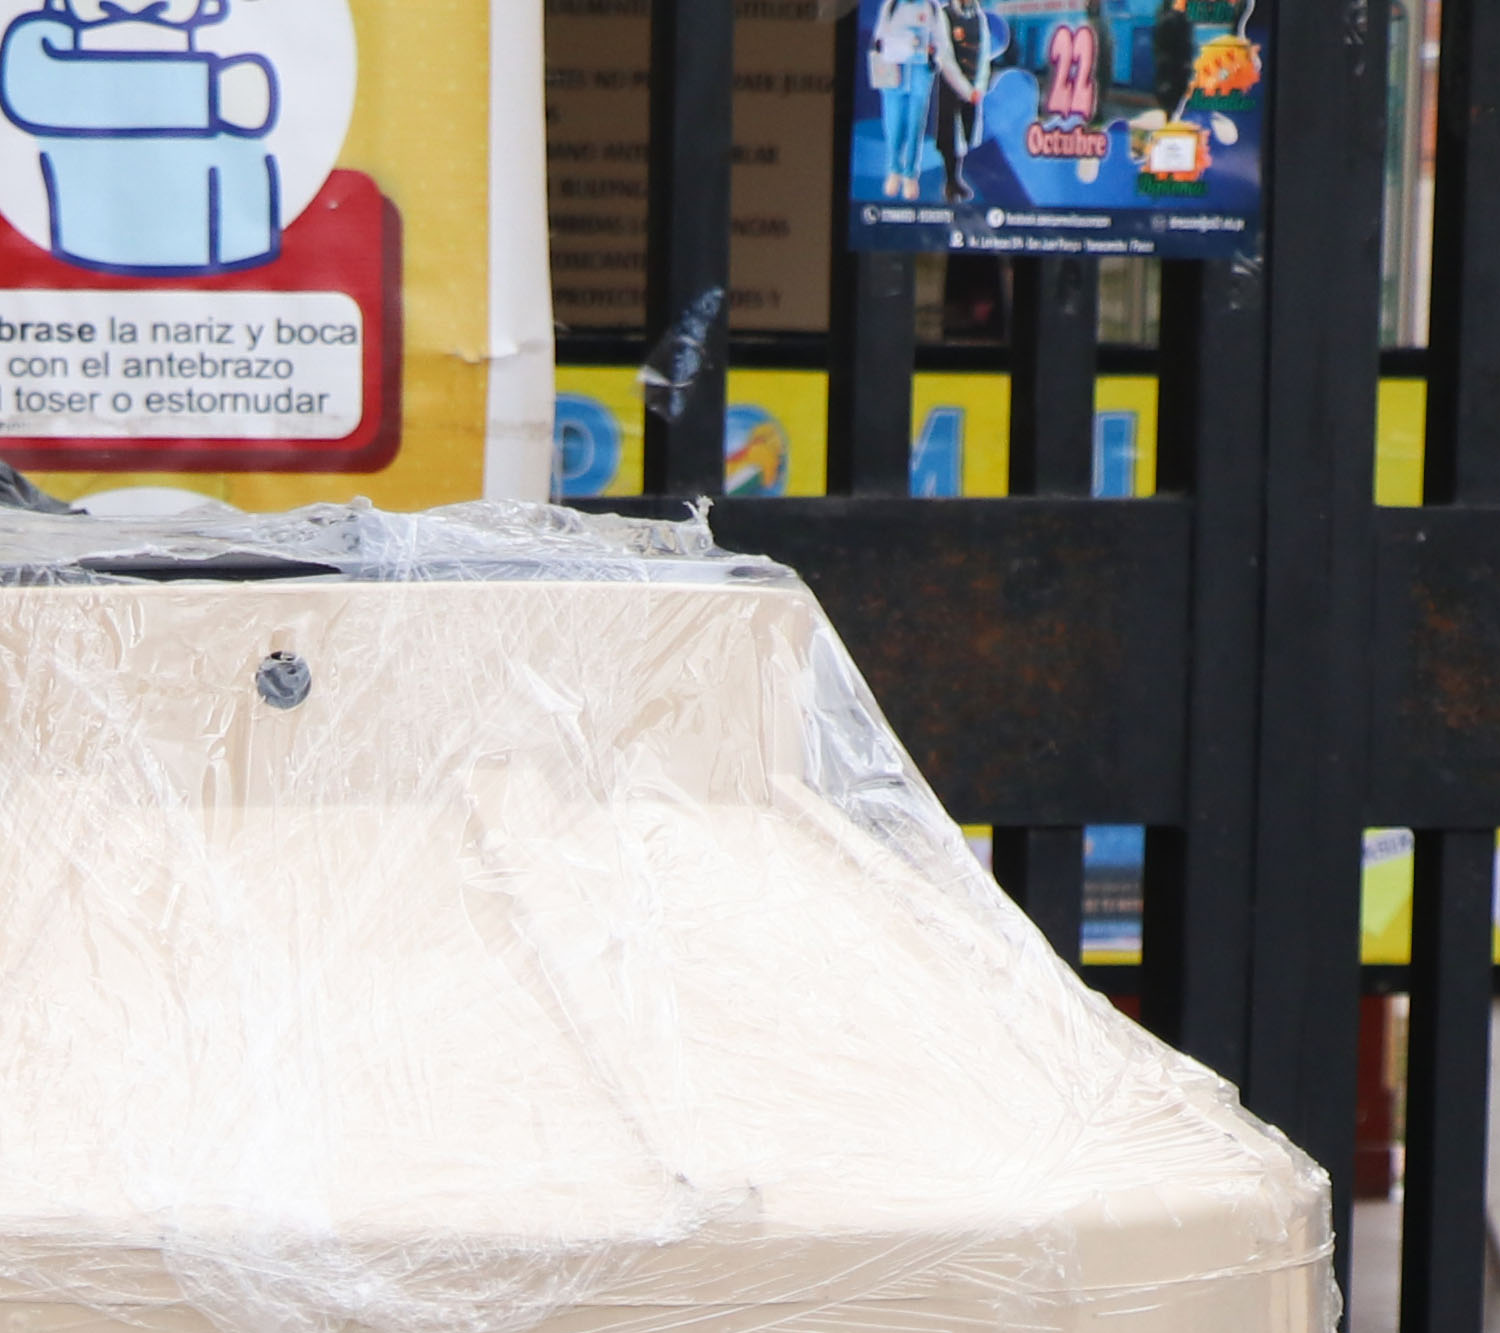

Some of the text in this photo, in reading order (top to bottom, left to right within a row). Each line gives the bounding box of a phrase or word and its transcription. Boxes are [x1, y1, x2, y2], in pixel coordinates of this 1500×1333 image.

[1048, 24, 1098, 120] 22
[1028, 125, 1108, 159] Octubre
[110, 316, 139, 343] la
[151, 318, 233, 344] nariz
[244, 322, 264, 350] y
[275, 318, 358, 345] boca
[7, 352, 295, 380] con el antebrazo
[15, 387, 101, 414] toser
[112, 392, 133, 414] o
[144, 387, 331, 414] estornudar
